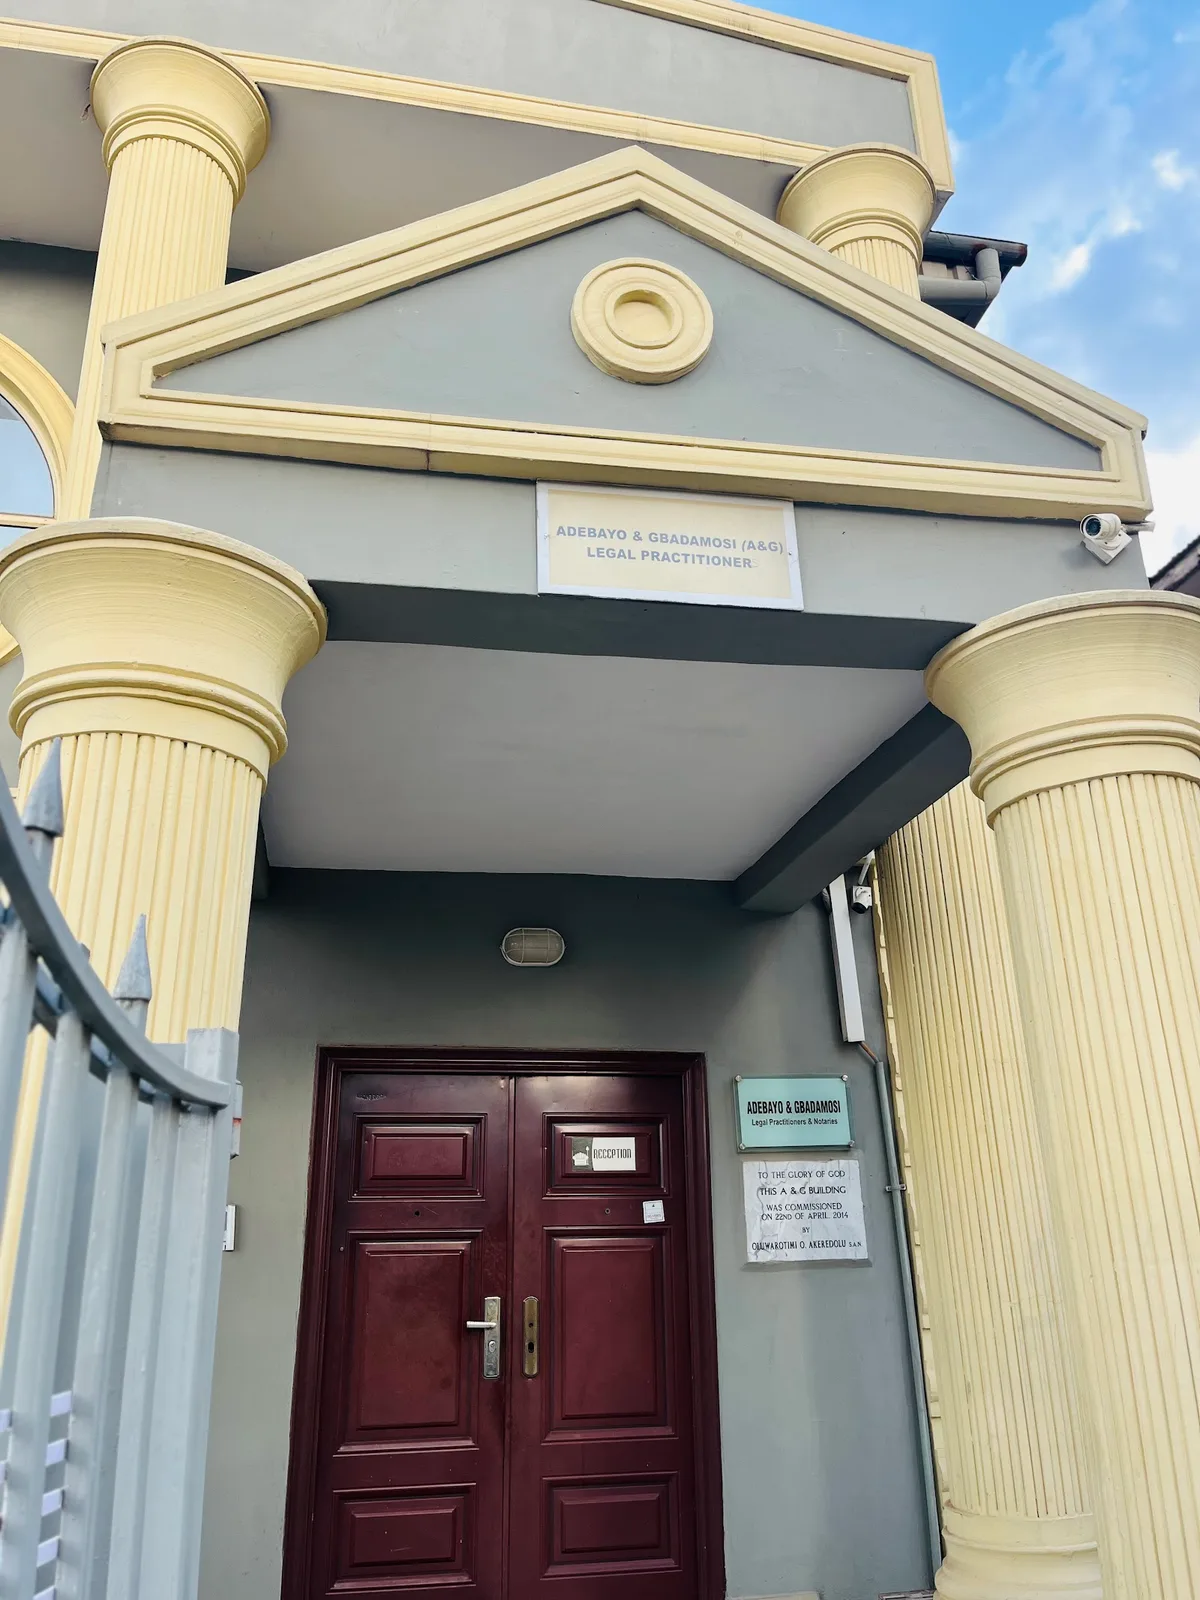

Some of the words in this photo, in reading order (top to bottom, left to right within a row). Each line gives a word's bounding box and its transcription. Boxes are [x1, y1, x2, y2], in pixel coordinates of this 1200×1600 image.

[556, 525, 627, 541] ADEBAYO
[632, 531, 643, 542] &
[648, 532, 737, 549] GBADAMOSI
[741, 539, 784, 555] (A&G)
[587, 547, 637, 561] LEGAL
[747, 1100, 784, 1115] ADEBAYO
[786, 1101, 792, 1114] &
[794, 1100, 841, 1114] GBADAMOSI
[752, 1118, 768, 1127] Legal
[769, 1118, 807, 1126] Practitioners
[593, 1148, 632, 1159] RECEPTION
[758, 1171, 769, 1179] TO
[771, 1171, 786, 1179] THE
[788, 1170, 813, 1179] GLORY
[816, 1170, 825, 1178] OF
[828, 1170, 846, 1178] GOD
[760, 1187, 777, 1196] THIS
[780, 1187, 787, 1195] A
[790, 1187, 797, 1195] &
[799, 1186, 806, 1195] G
[809, 1186, 846, 1195] BUILDING
[766, 1204, 783, 1212] WAS
[785, 1202, 842, 1211] COMMISSIONED
[761, 1213, 773, 1221] ON
[795, 1212, 804, 1220] OF
[833, 1211, 849, 1219] 2014
[809, 1239, 846, 1248] AKEREDOLU
